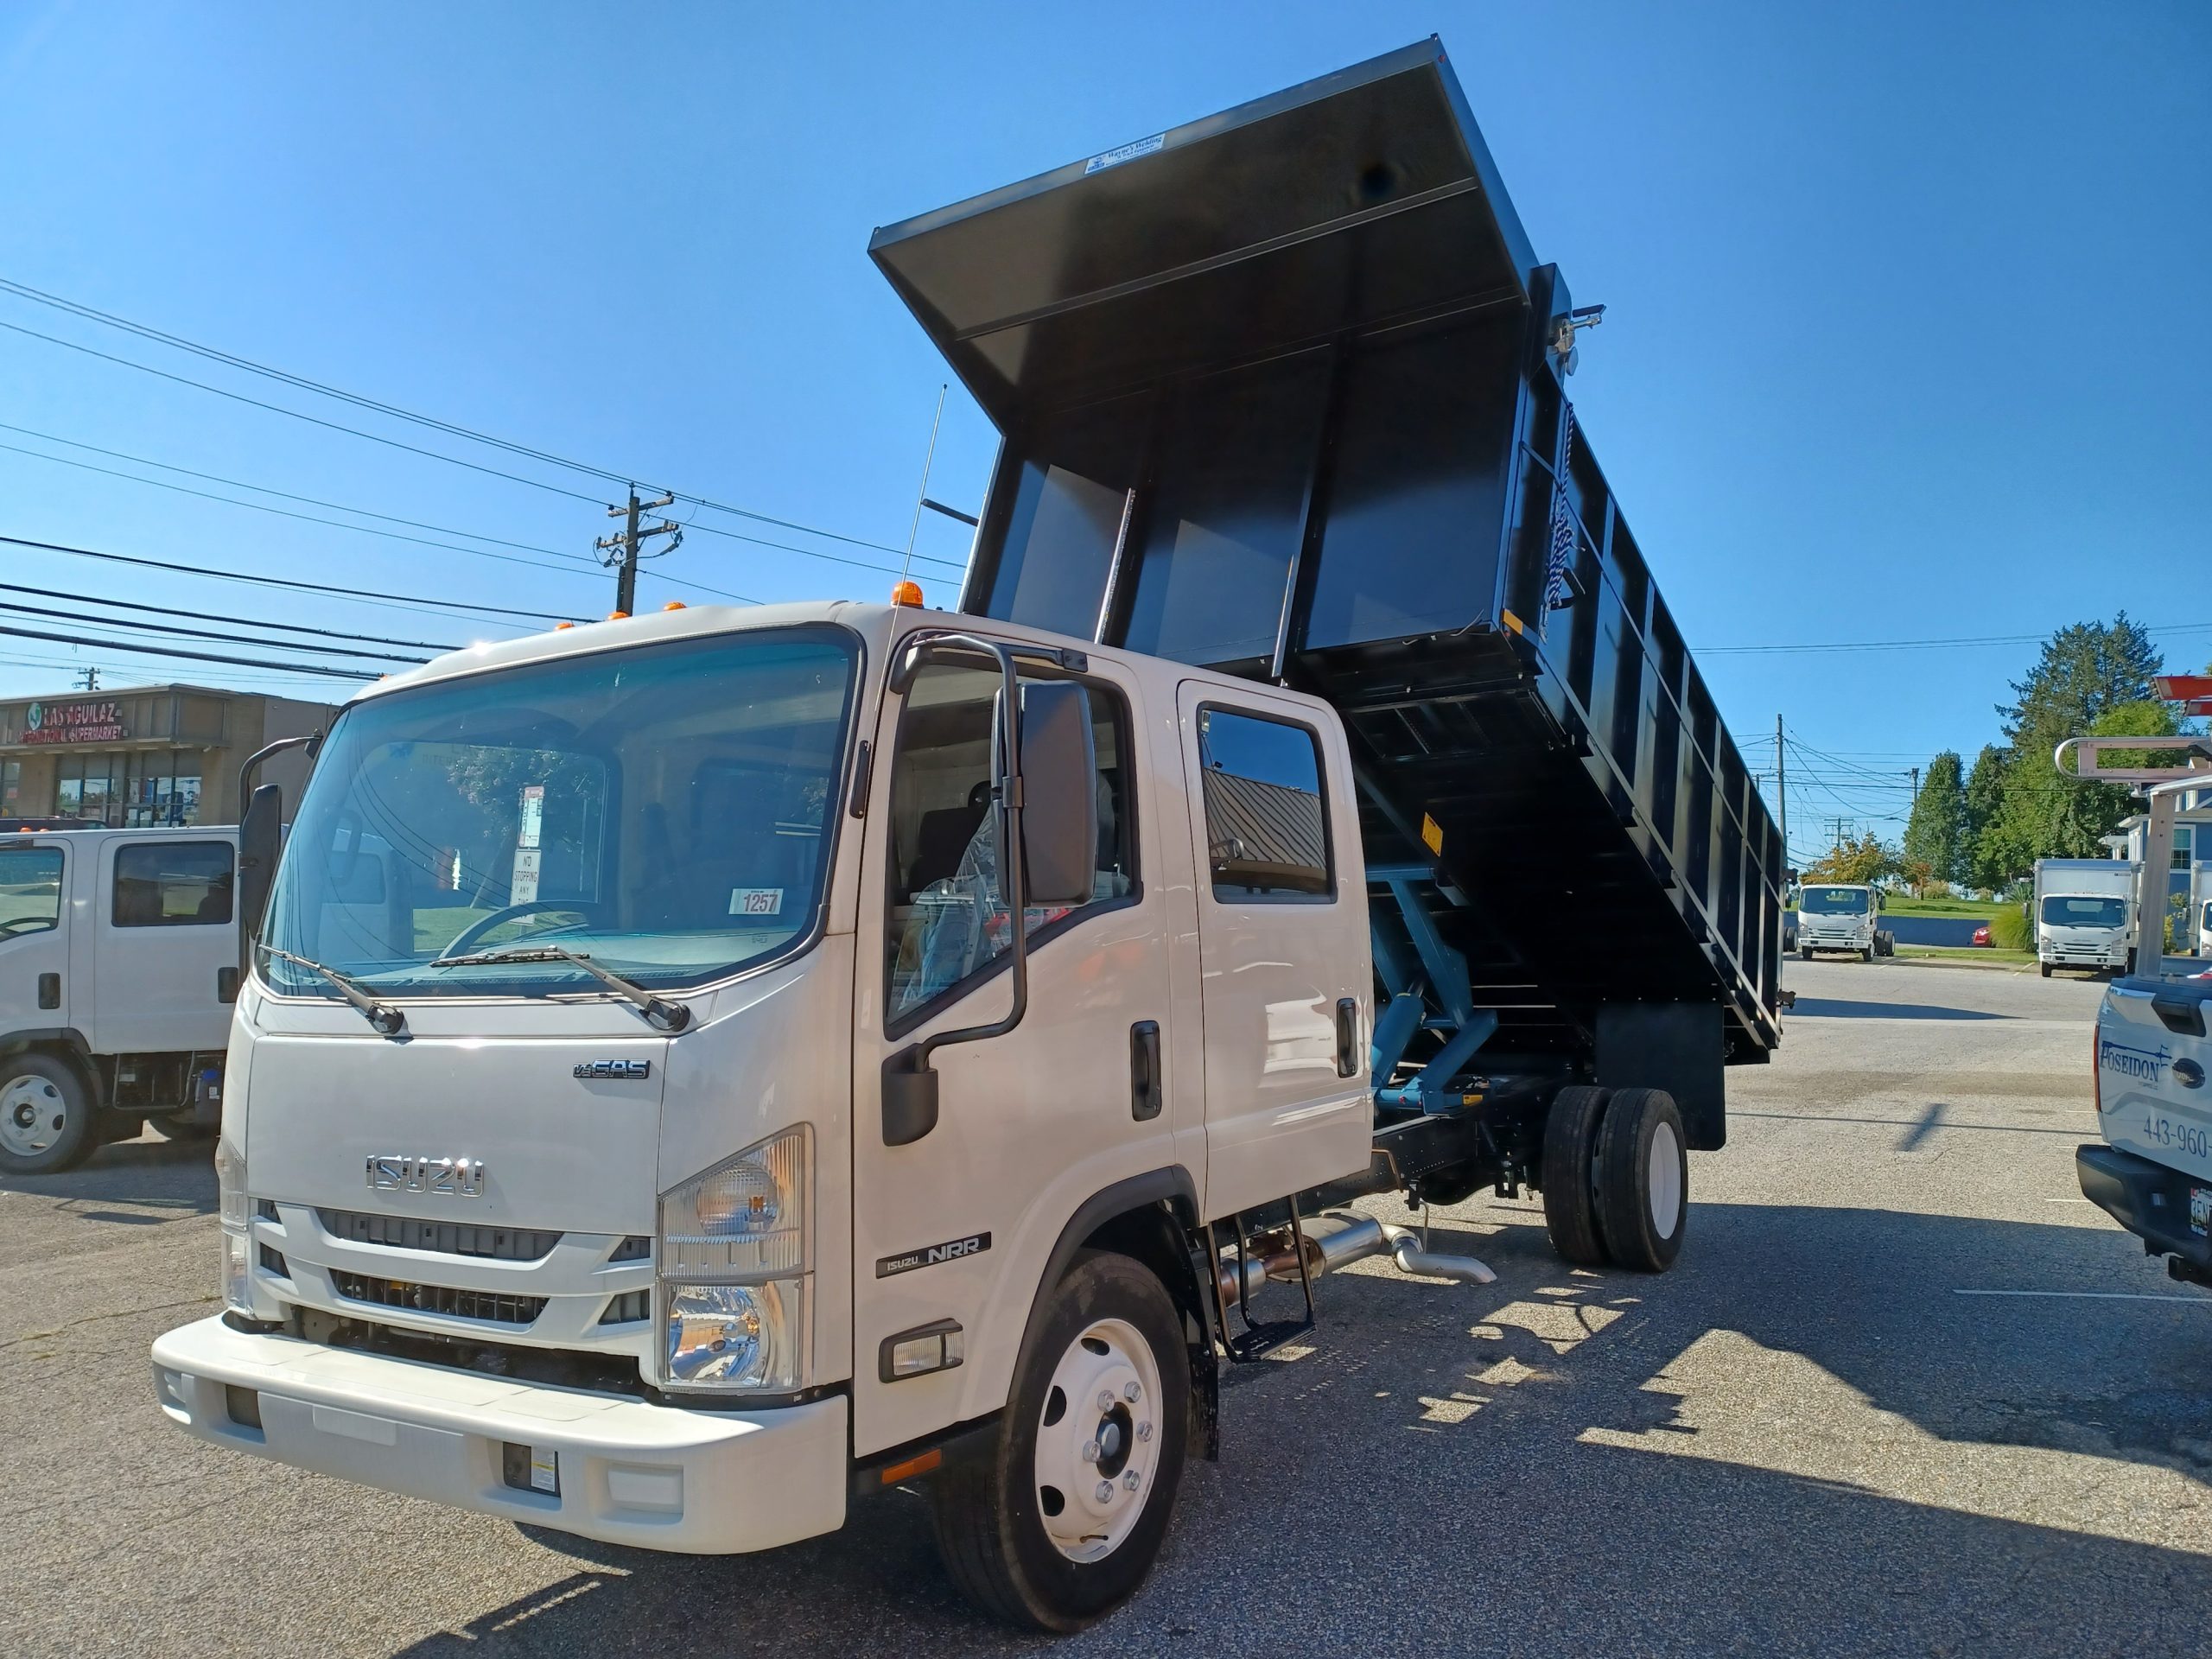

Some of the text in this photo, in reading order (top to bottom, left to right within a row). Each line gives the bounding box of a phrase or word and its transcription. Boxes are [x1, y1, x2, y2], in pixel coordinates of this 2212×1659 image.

[1135, 137, 1161, 149] Welding
[44, 702, 115, 726] LAS AGUILAZ
[69, 725, 122, 743] SUPERMARKET
[523, 855, 532, 867] NO
[515, 870, 537, 882] STOPPING
[519, 886, 530, 895] ANY
[743, 893, 779, 912] 1257
[591, 1059, 646, 1078] GAS
[2100, 1045, 2159, 1083] POSEIDON
[365, 1154, 483, 1198] ISUZU
[887, 1237, 980, 1271] ISUZU NRR
